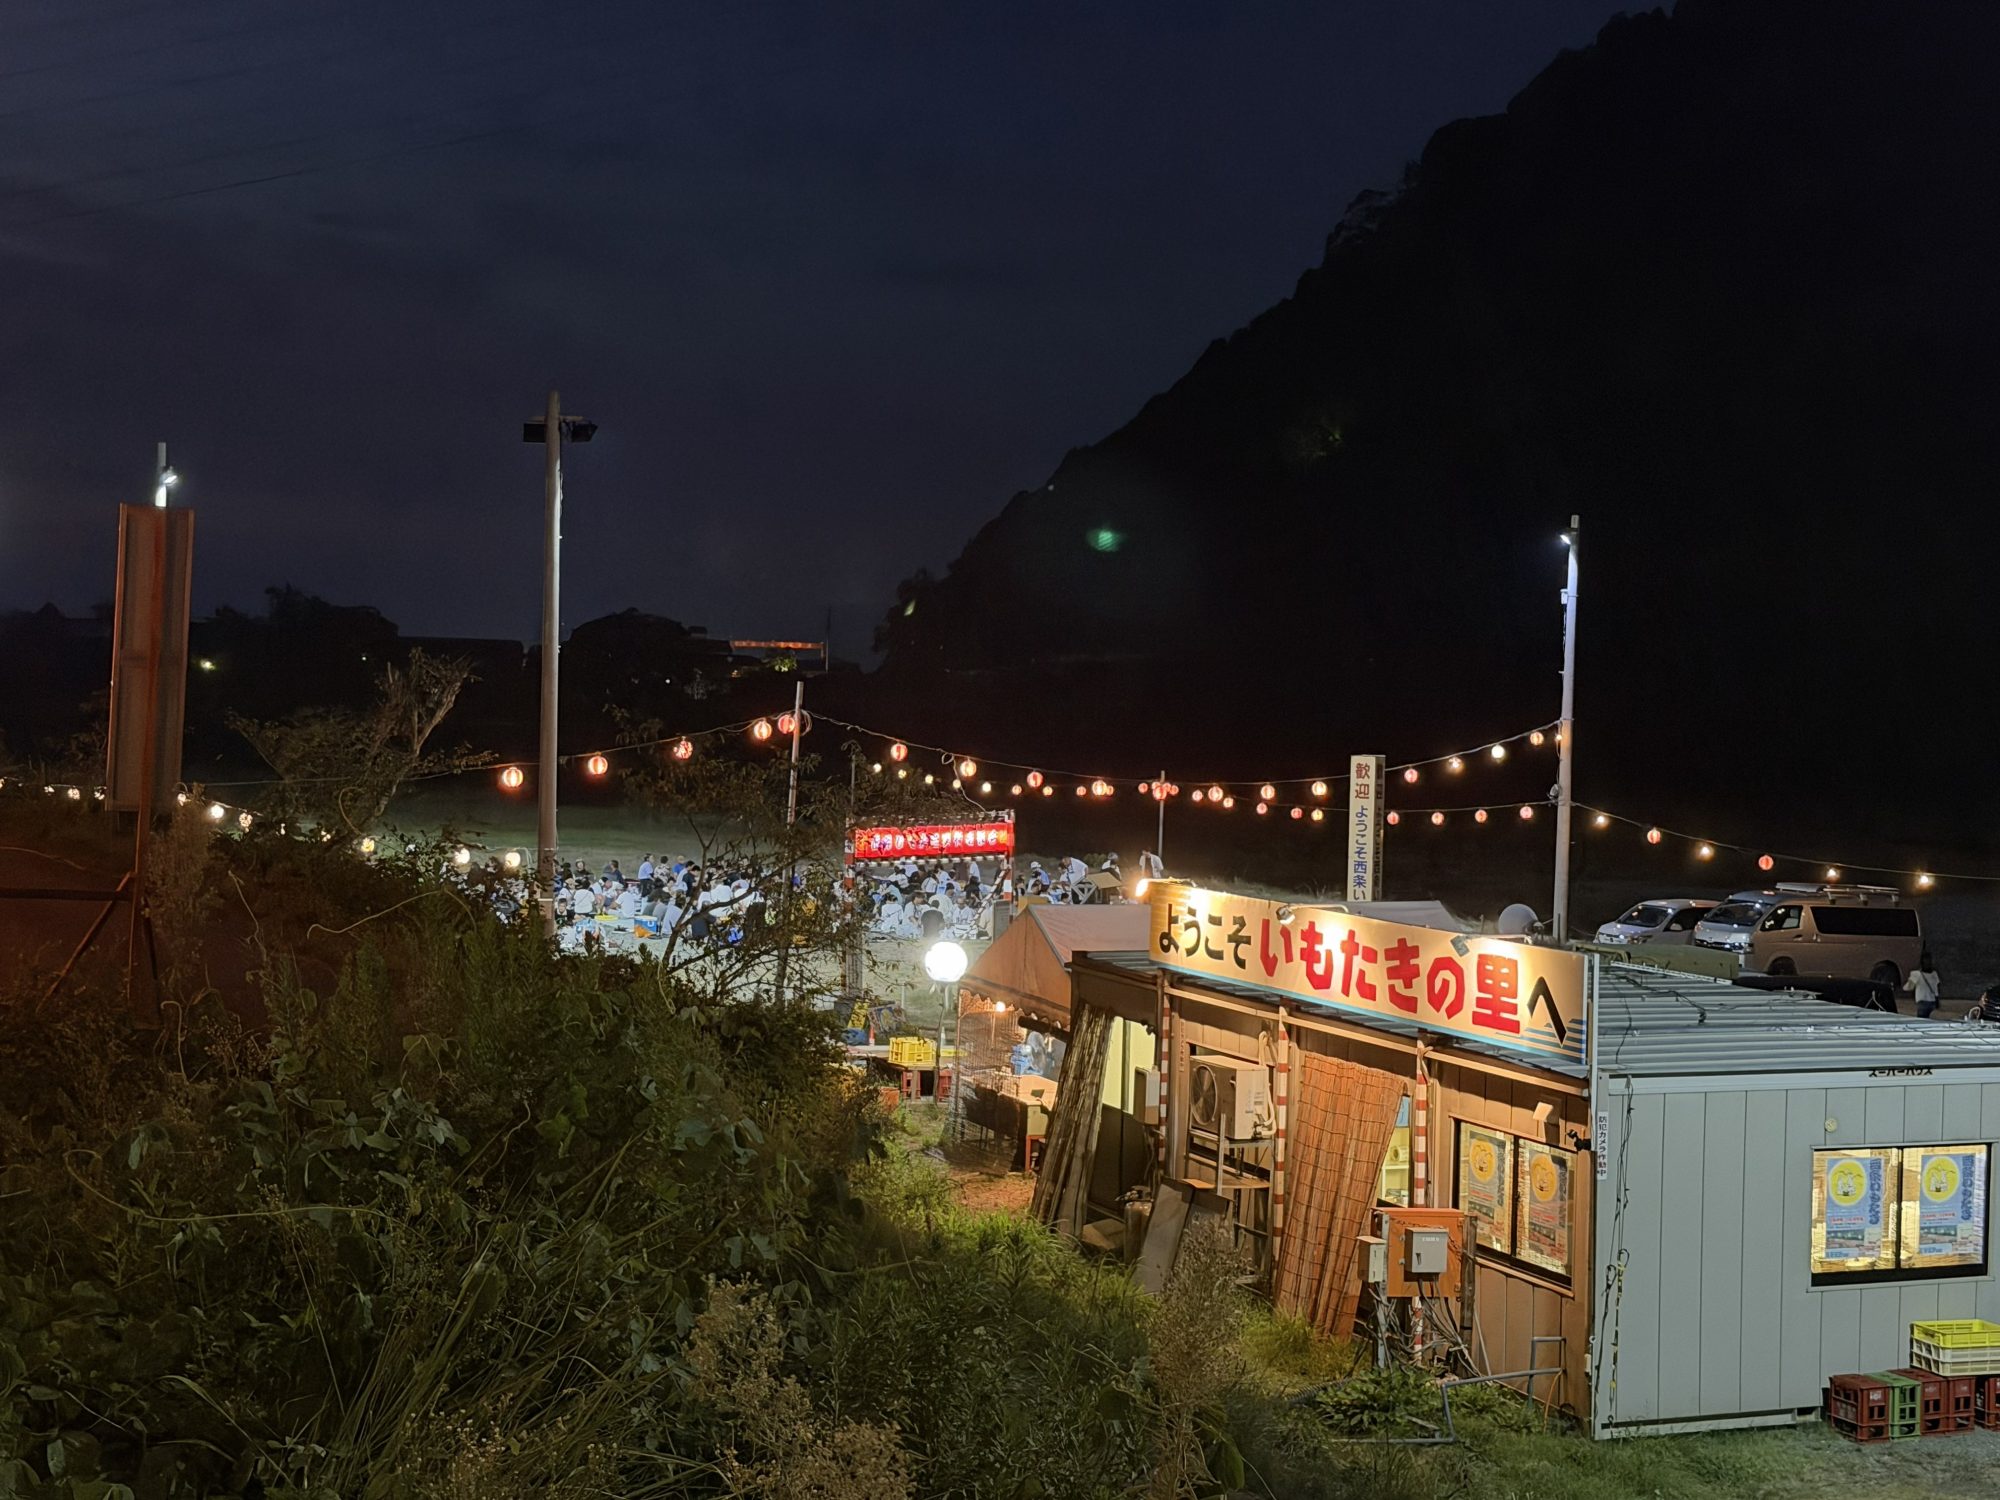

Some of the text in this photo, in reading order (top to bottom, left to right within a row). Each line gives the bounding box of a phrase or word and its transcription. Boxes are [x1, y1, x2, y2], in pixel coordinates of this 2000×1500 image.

[1355, 762, 1370, 800] 歓迎
[1354, 806, 1368, 901] ようこそ西条い
[1158, 903, 1568, 1048] ようこそいもたきの里へ
